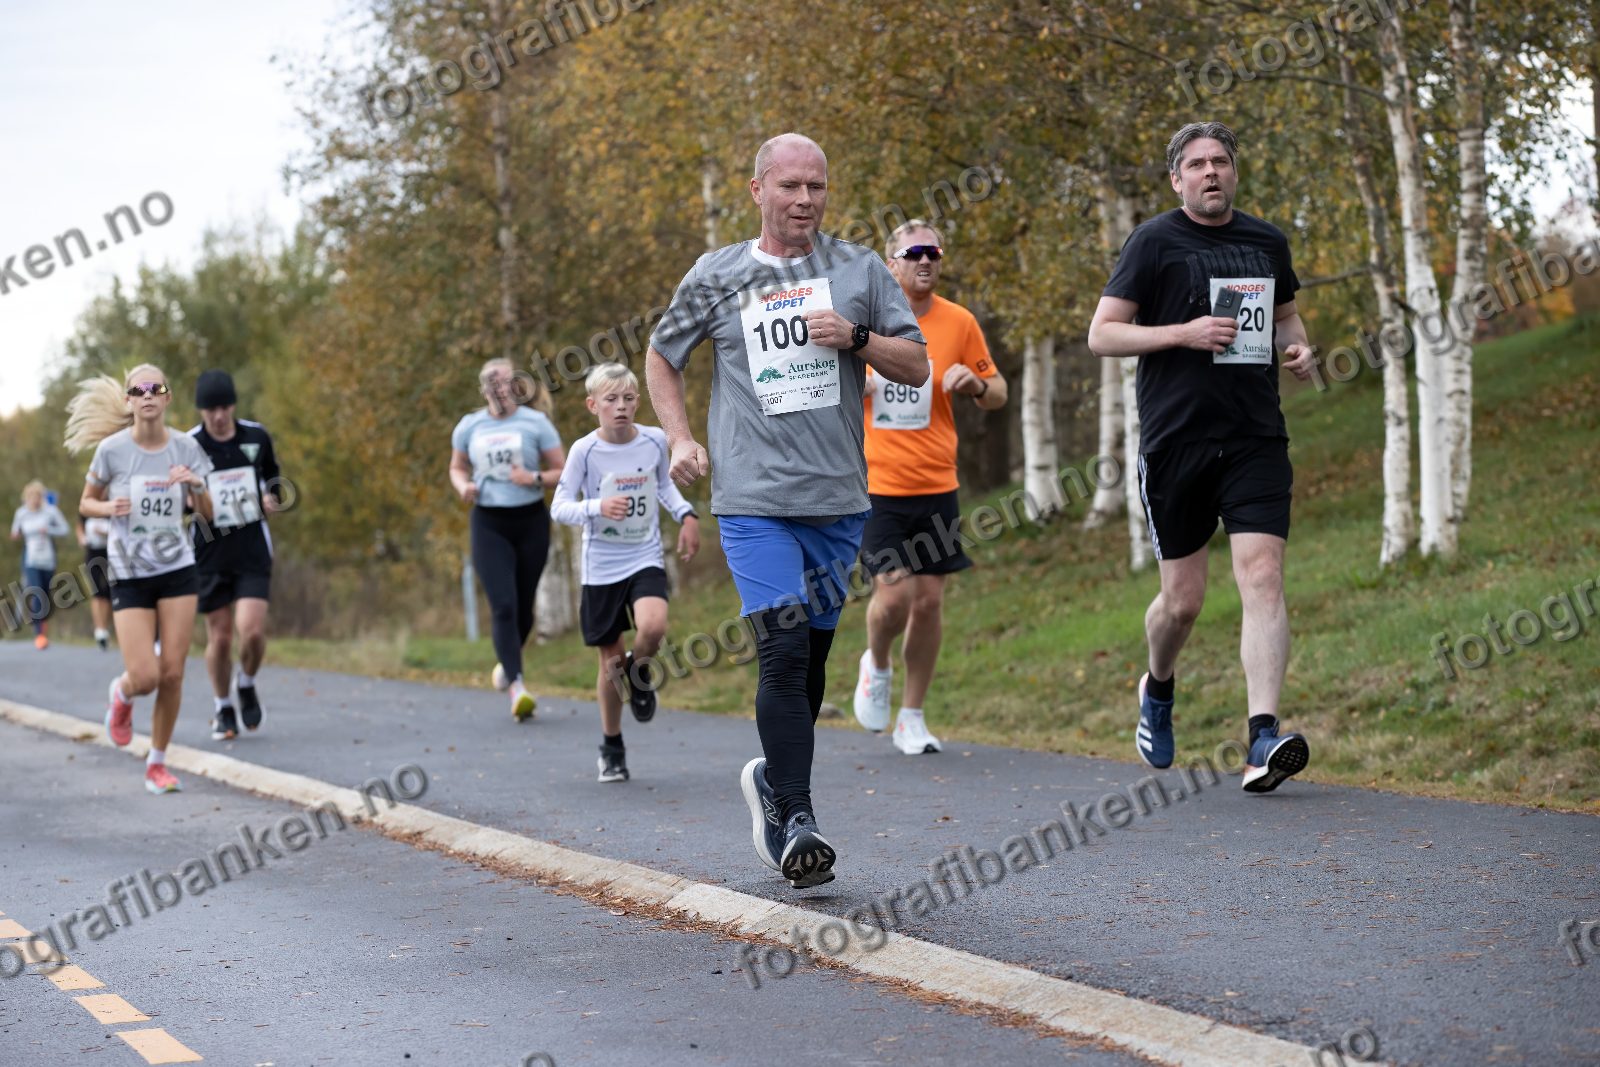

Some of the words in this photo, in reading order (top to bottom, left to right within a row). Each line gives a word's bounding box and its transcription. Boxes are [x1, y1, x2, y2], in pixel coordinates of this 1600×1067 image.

[760, 287, 813, 304] NORGES
[1227, 284, 1265, 292] NORGES
[766, 297, 805, 311] LØPET
[1240, 307, 1264, 332] 20
[753, 315, 808, 355] 100
[788, 359, 836, 373] Aurskog
[884, 383, 920, 404] 696
[141, 497, 173, 516] 942
[626, 496, 646, 517] 95
